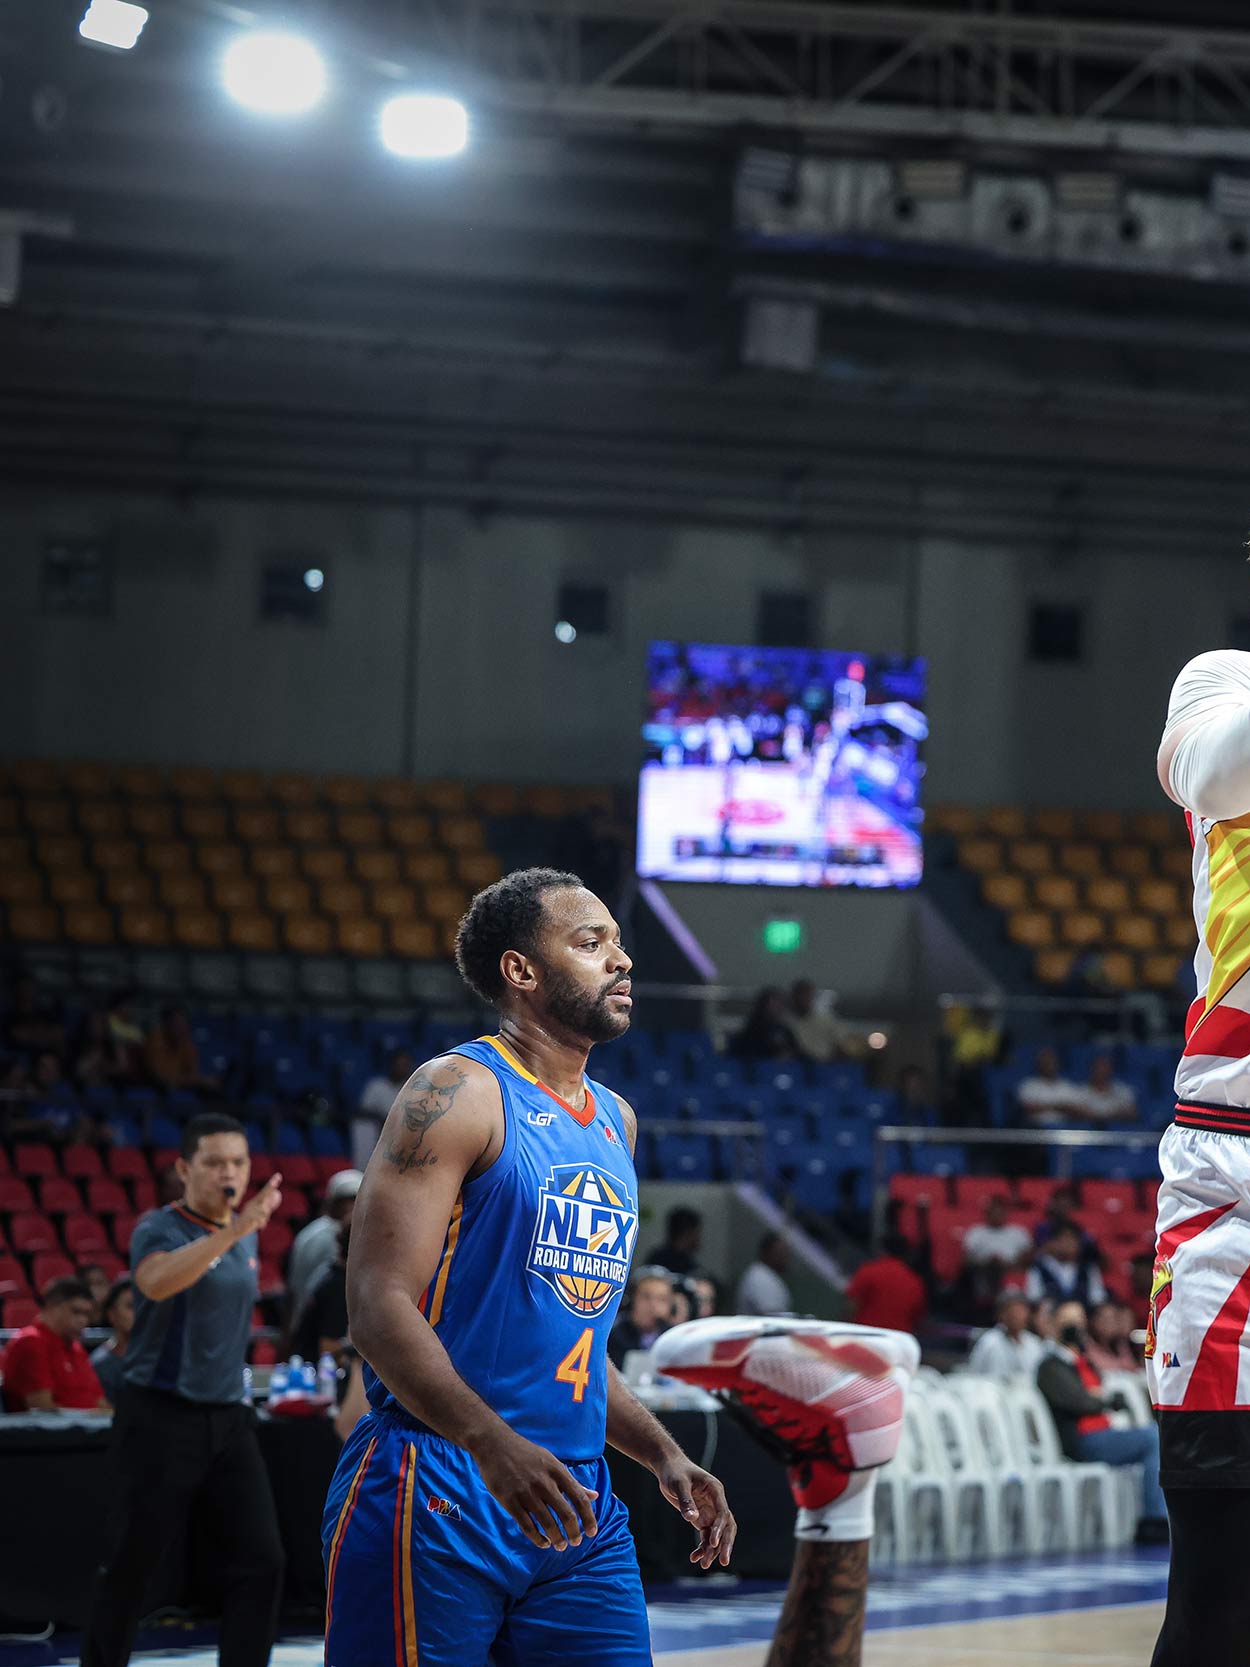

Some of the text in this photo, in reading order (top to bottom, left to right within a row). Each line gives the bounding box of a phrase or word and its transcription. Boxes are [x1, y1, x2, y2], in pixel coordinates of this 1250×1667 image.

[541, 1198, 635, 1260] NLEX
[533, 1246, 628, 1284] ROAD WARRIORS
[555, 1327, 594, 1403] 4
[426, 1494, 462, 1521] PBA
